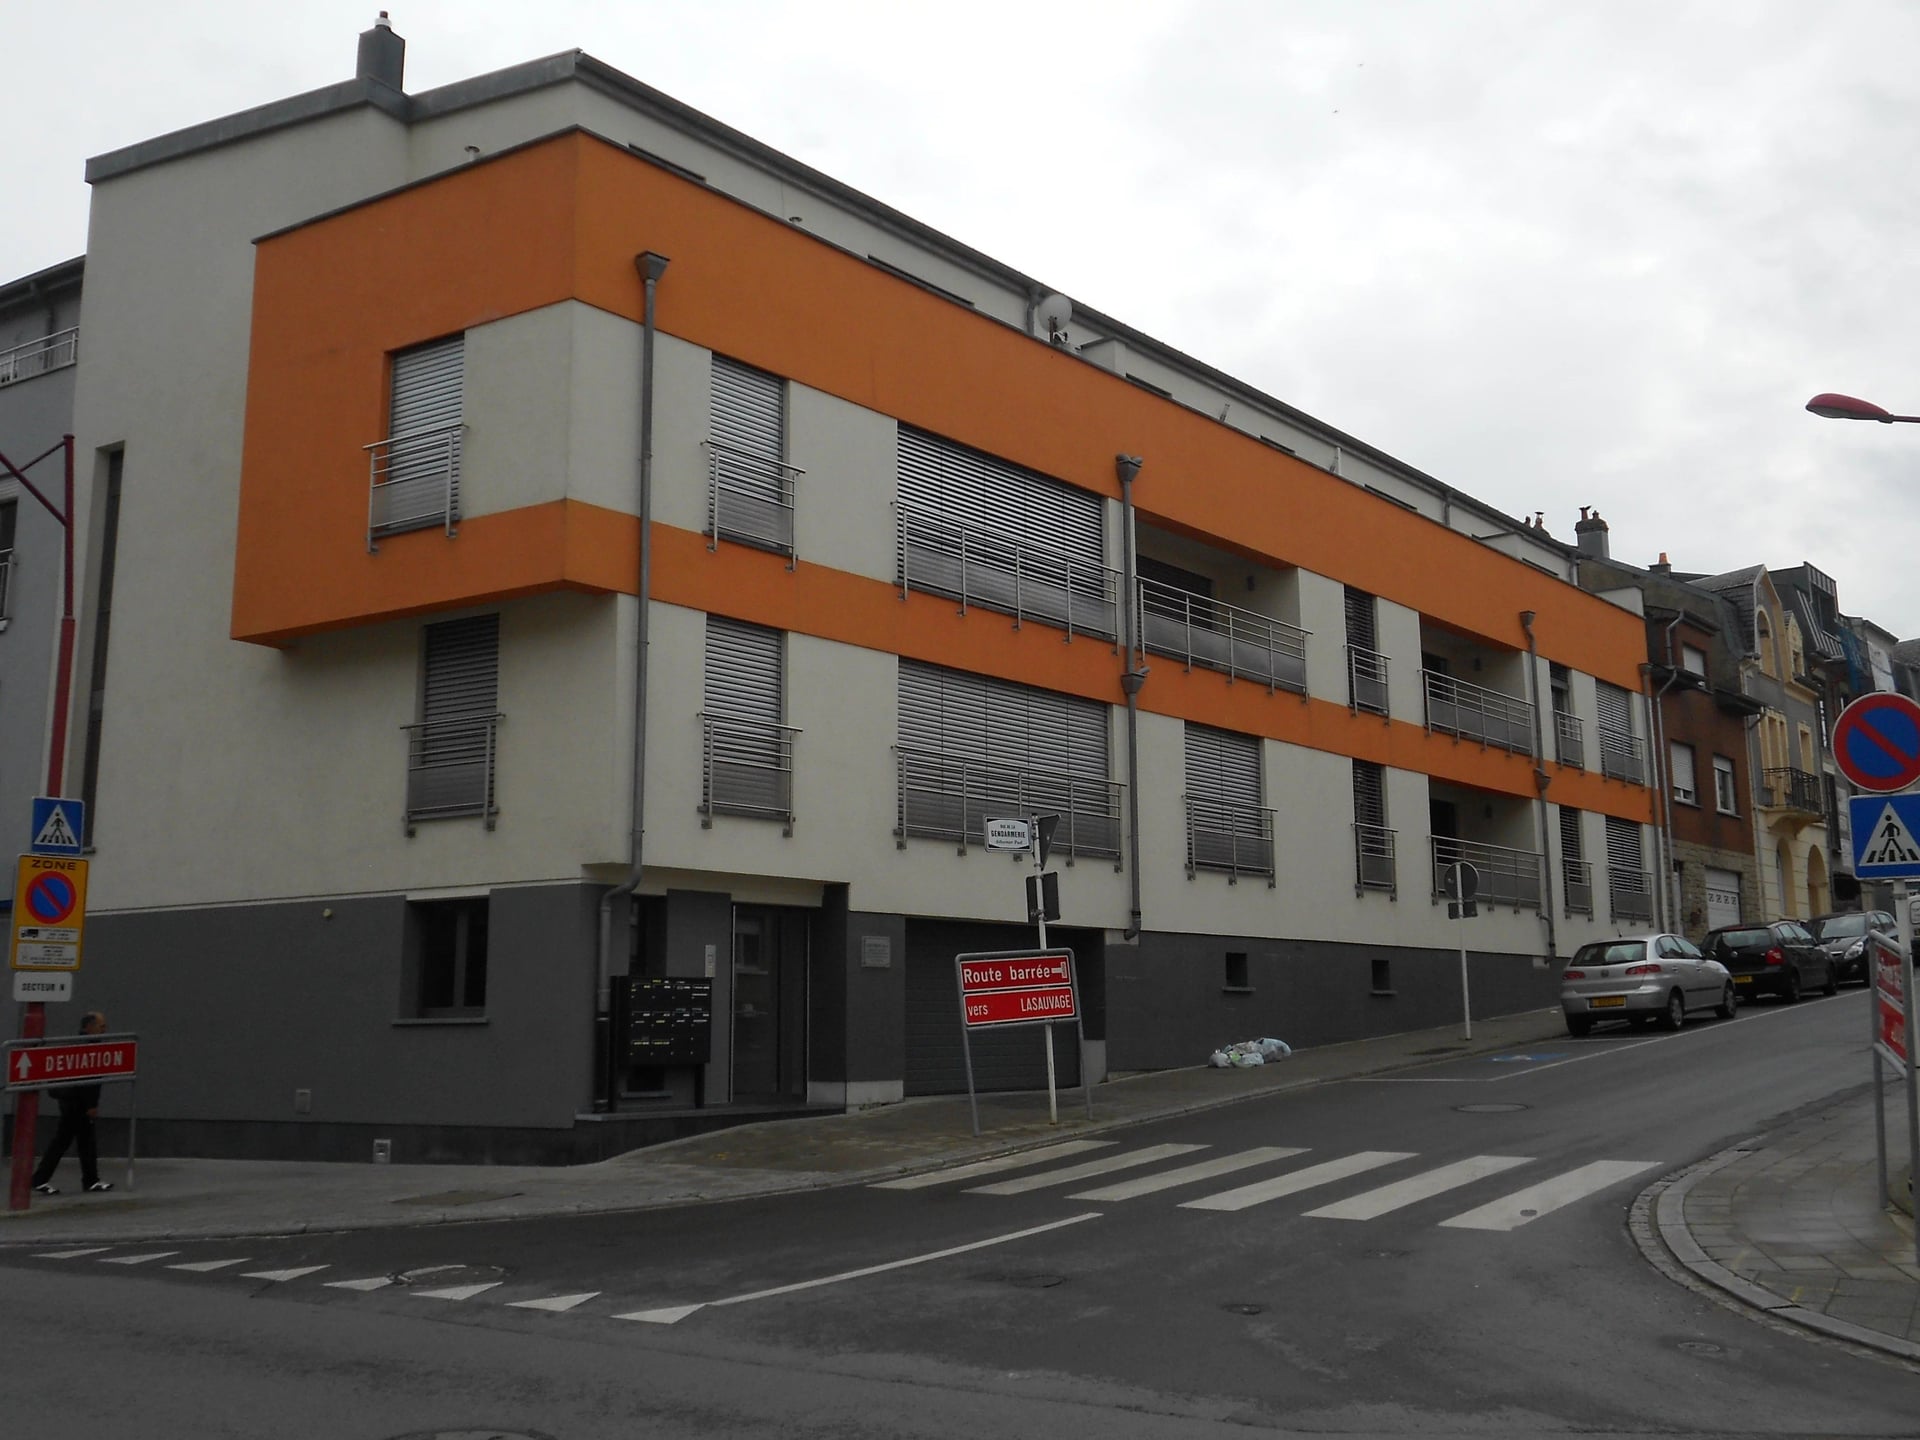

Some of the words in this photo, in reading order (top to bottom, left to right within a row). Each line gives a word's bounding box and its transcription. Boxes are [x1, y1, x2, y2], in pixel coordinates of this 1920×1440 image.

[991, 830, 1026, 838] GENDARMERIE
[32, 859, 77, 870] ZONE
[963, 967, 1002, 984] Route
[1009, 964, 1050, 980] barrée
[22, 983, 56, 992] SECTEUR
[968, 1004, 989, 1017] vers
[1020, 994, 1072, 1012] LASAUVAGE
[45, 1050, 123, 1073] DEVIATION
